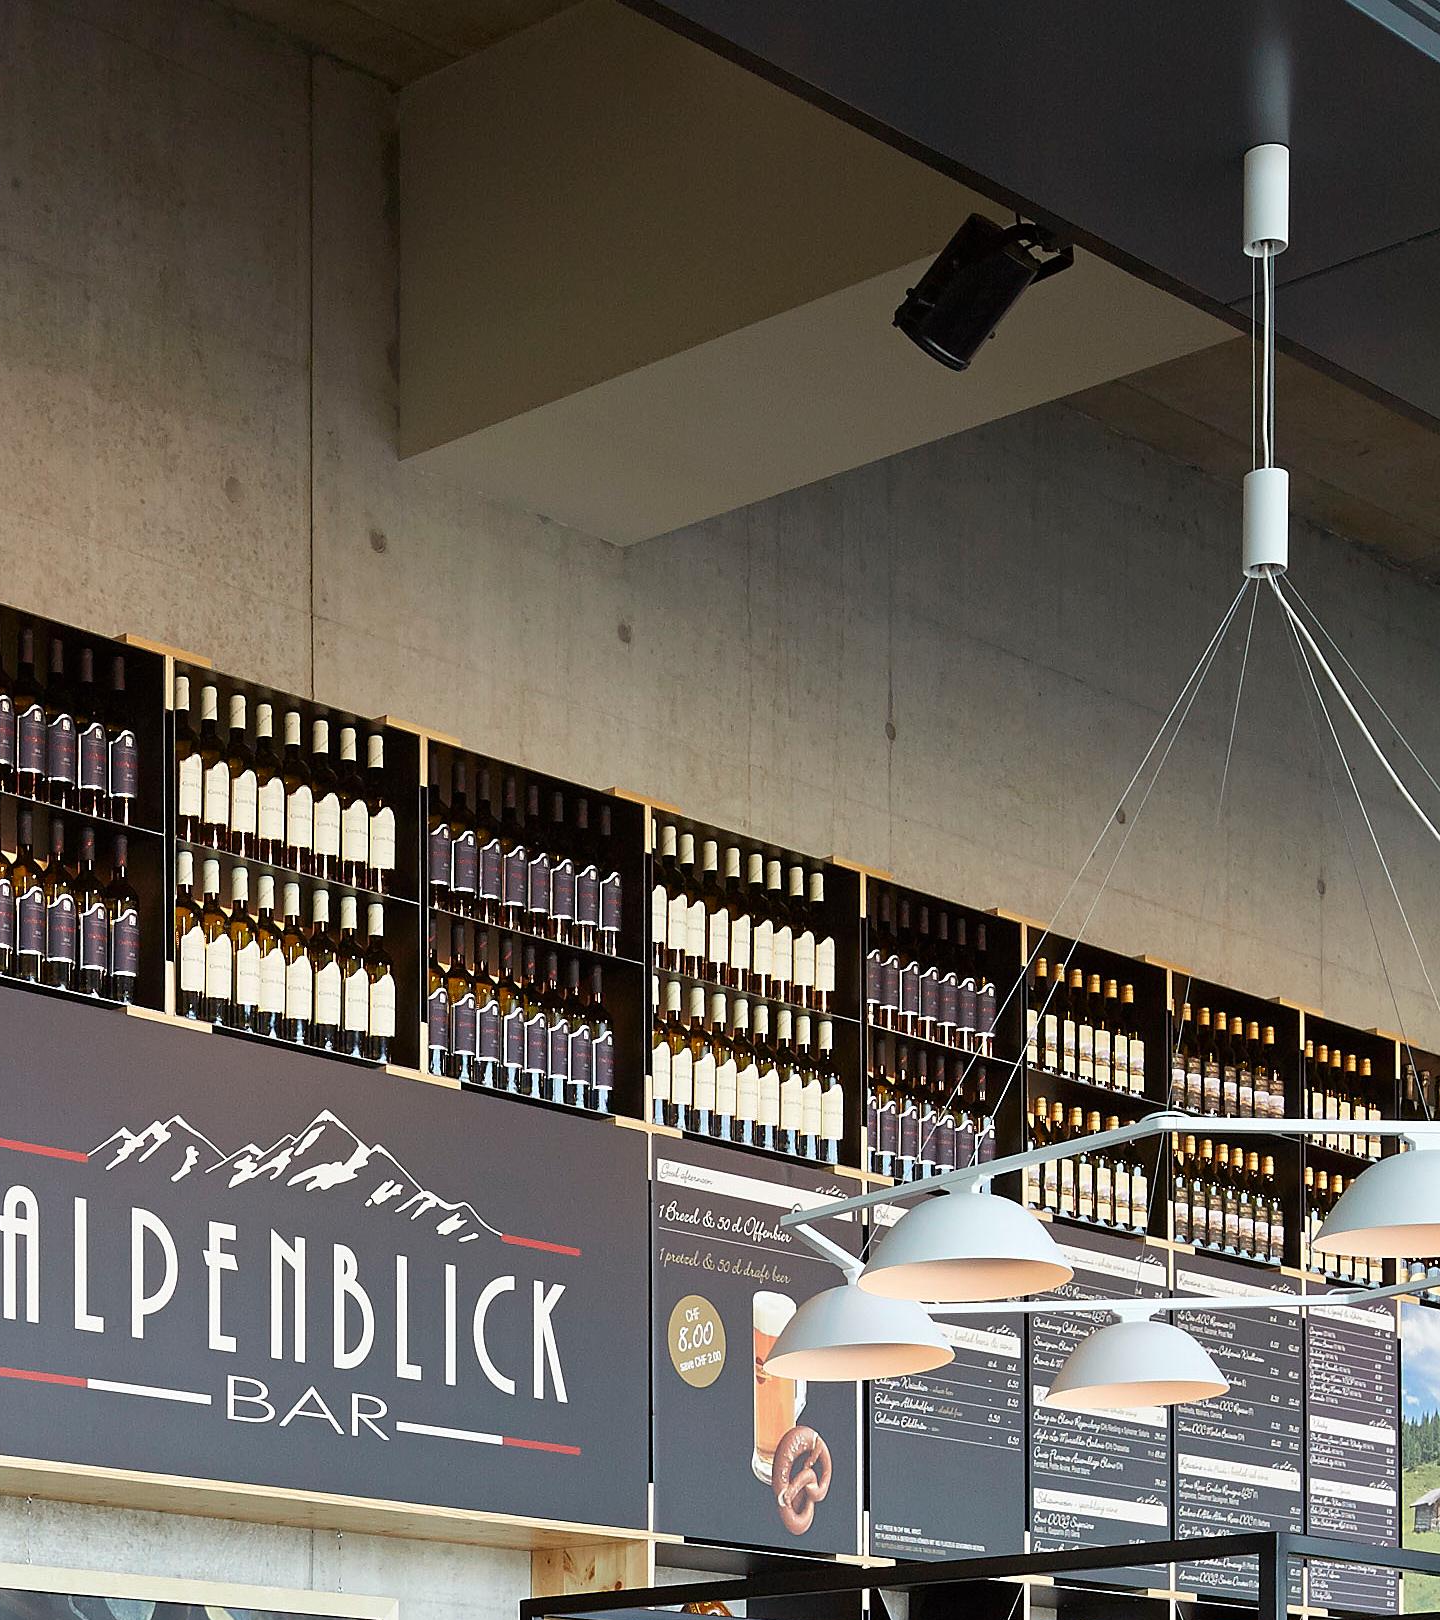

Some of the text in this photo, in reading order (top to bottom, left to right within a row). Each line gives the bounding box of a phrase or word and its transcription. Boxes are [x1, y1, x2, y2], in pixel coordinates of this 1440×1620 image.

[665, 1201, 792, 1243] Brezel & 50 Offenbier
[664, 1254, 791, 1284] pretzel & 50 draft beer
[686, 1307, 700, 1323] CHF
[678, 1321, 714, 1352] 8.00
[680, 1350, 721, 1372] save CHF 2.00
[226, 1375, 390, 1441] BAR
